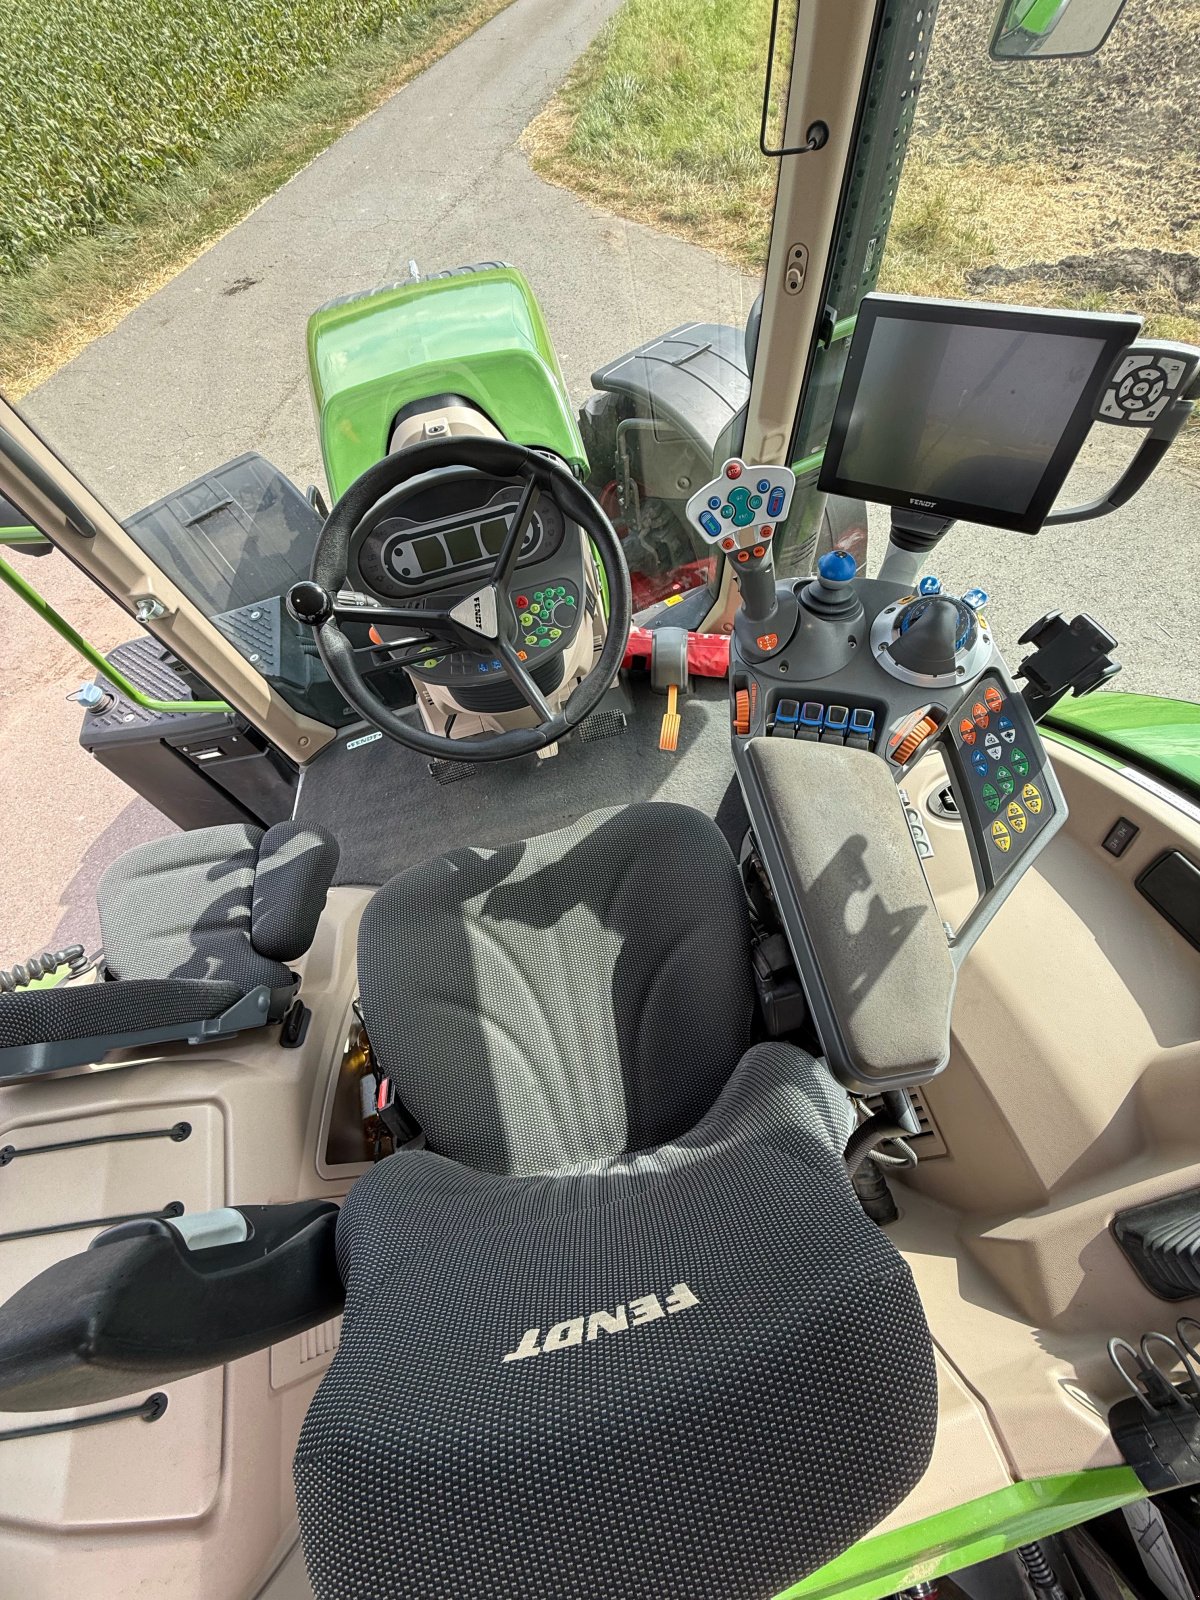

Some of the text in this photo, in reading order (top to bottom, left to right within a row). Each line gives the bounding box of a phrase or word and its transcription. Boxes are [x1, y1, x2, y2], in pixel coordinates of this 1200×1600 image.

[909, 497, 937, 508] FENDT
[473, 596, 482, 631] FENDT
[350, 733, 379, 747] FENDT
[501, 1282, 701, 1363] FENDT
